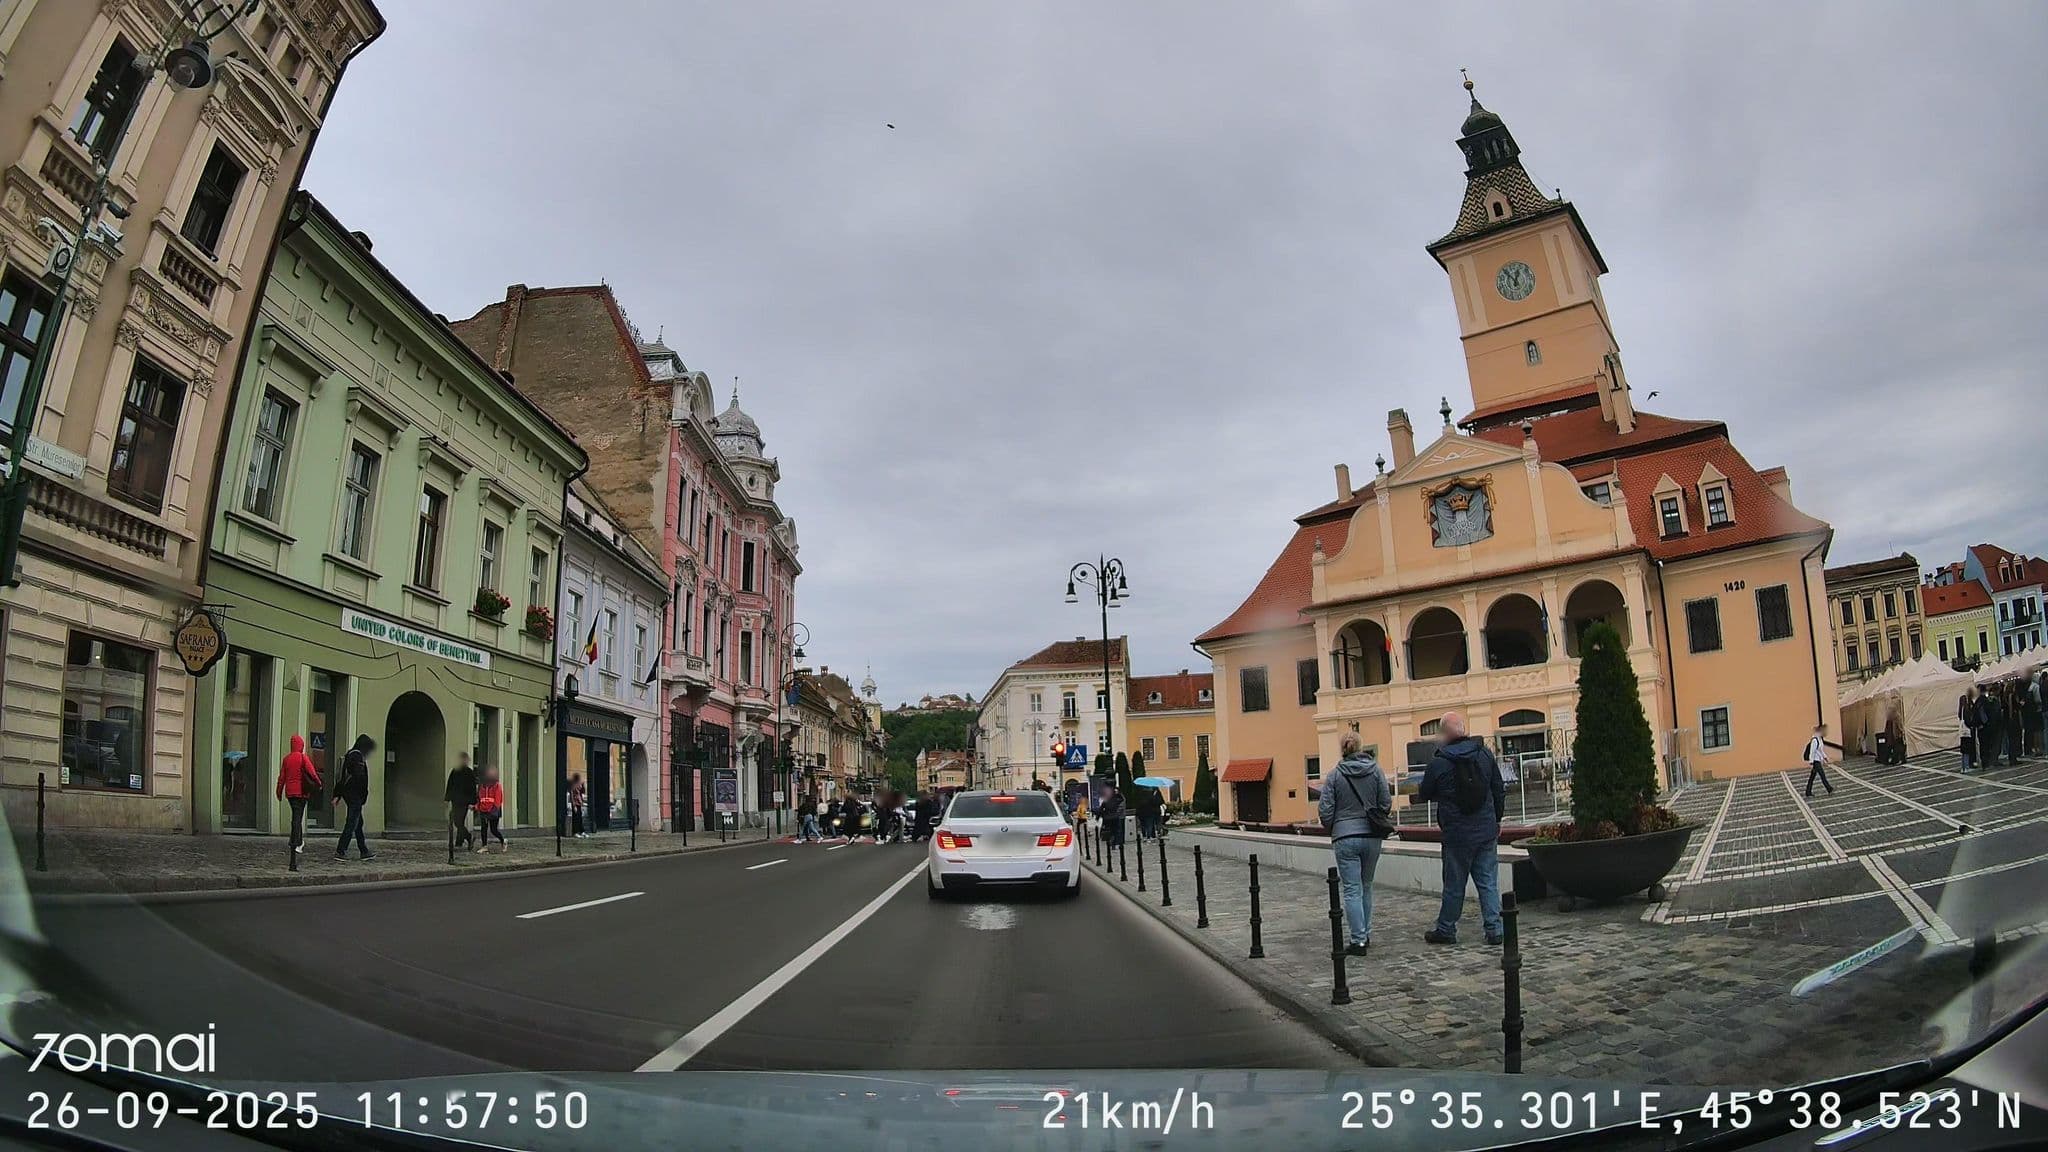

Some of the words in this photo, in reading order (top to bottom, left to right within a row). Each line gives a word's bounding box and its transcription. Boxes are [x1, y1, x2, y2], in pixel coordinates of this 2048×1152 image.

[1724, 580, 1745, 592] 1420
[179, 632, 217, 648] SAFRANO
[351, 615, 386, 637] UNITED
[389, 626, 424, 648] COLORS
[427, 638, 438, 651] OF
